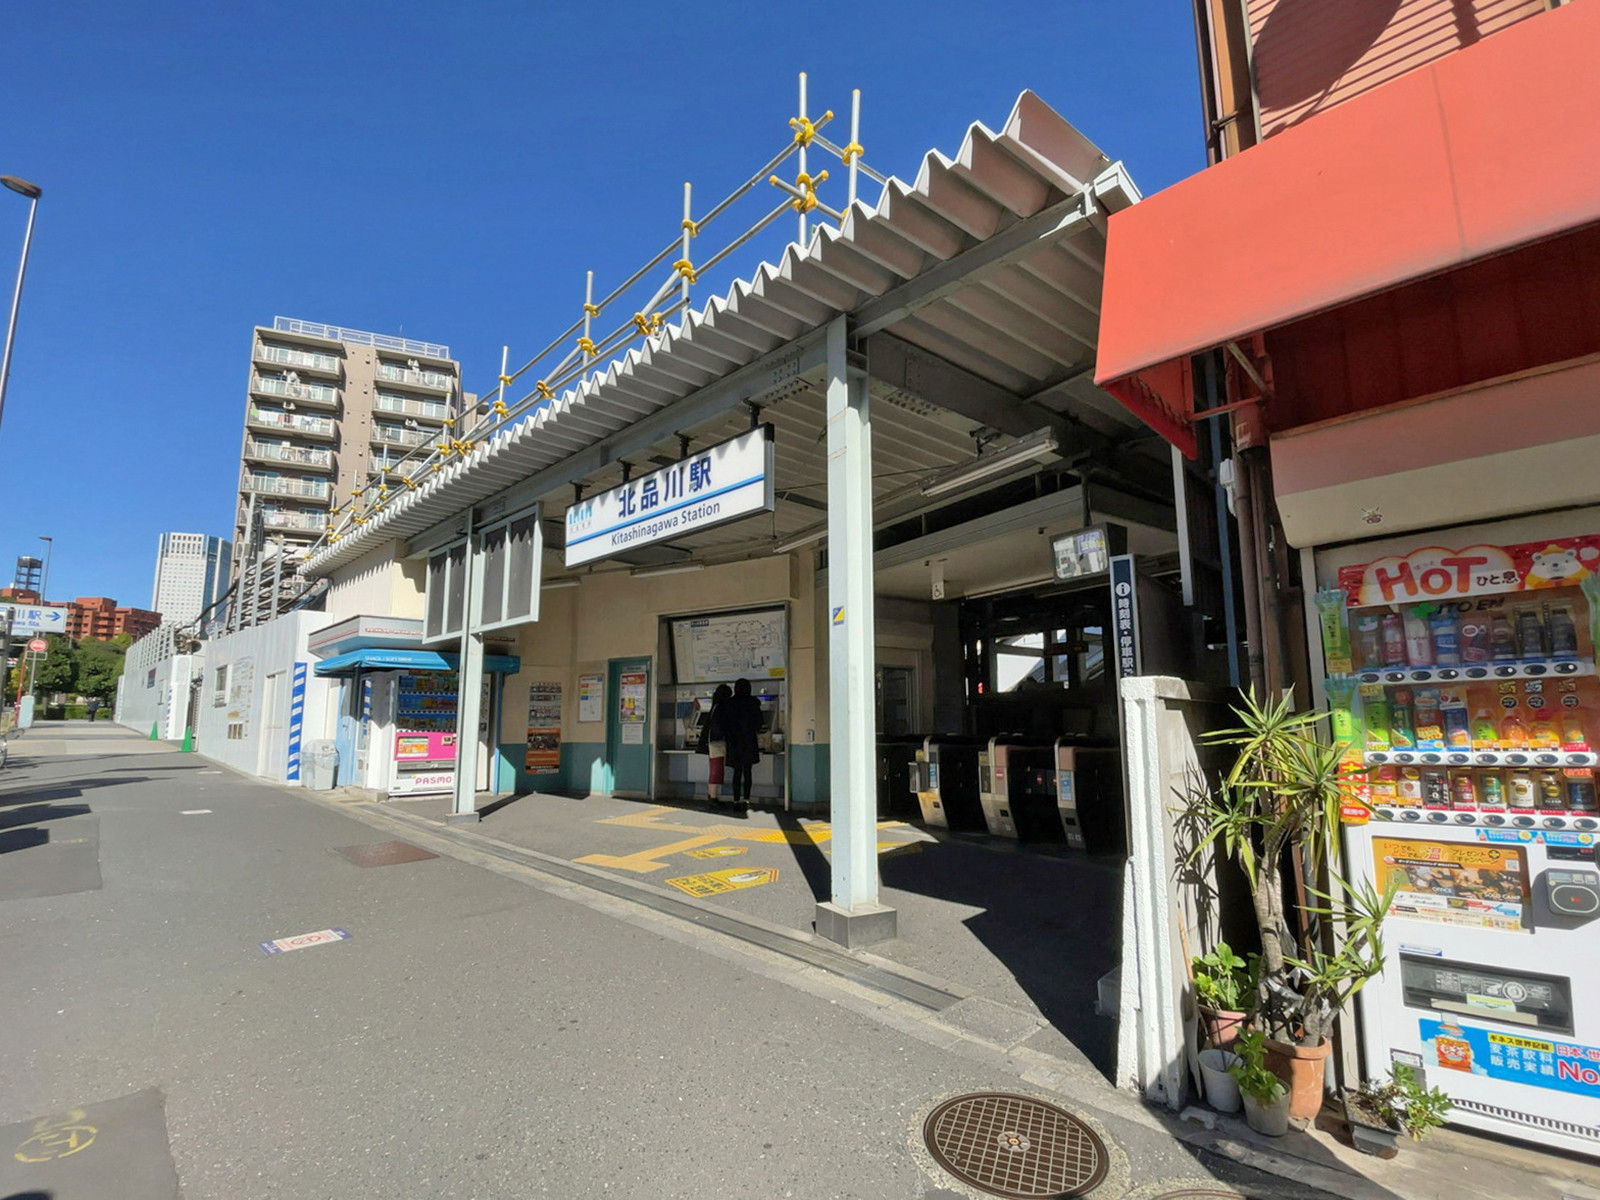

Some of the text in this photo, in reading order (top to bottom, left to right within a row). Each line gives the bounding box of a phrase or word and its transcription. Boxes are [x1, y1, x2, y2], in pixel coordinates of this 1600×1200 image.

[618, 456, 712, 518] 北品川駅
[611, 515, 679, 546] Kitashinagawa
[681, 502, 720, 525] Station
[1375, 556, 1488, 602] HOT
[1476, 570, 1519, 587] ひと息
[415, 776, 452, 784] PASMO
[1489, 1043, 1553, 1064] 麦茶飲料
[1490, 1055, 1555, 1077] 販売実績
